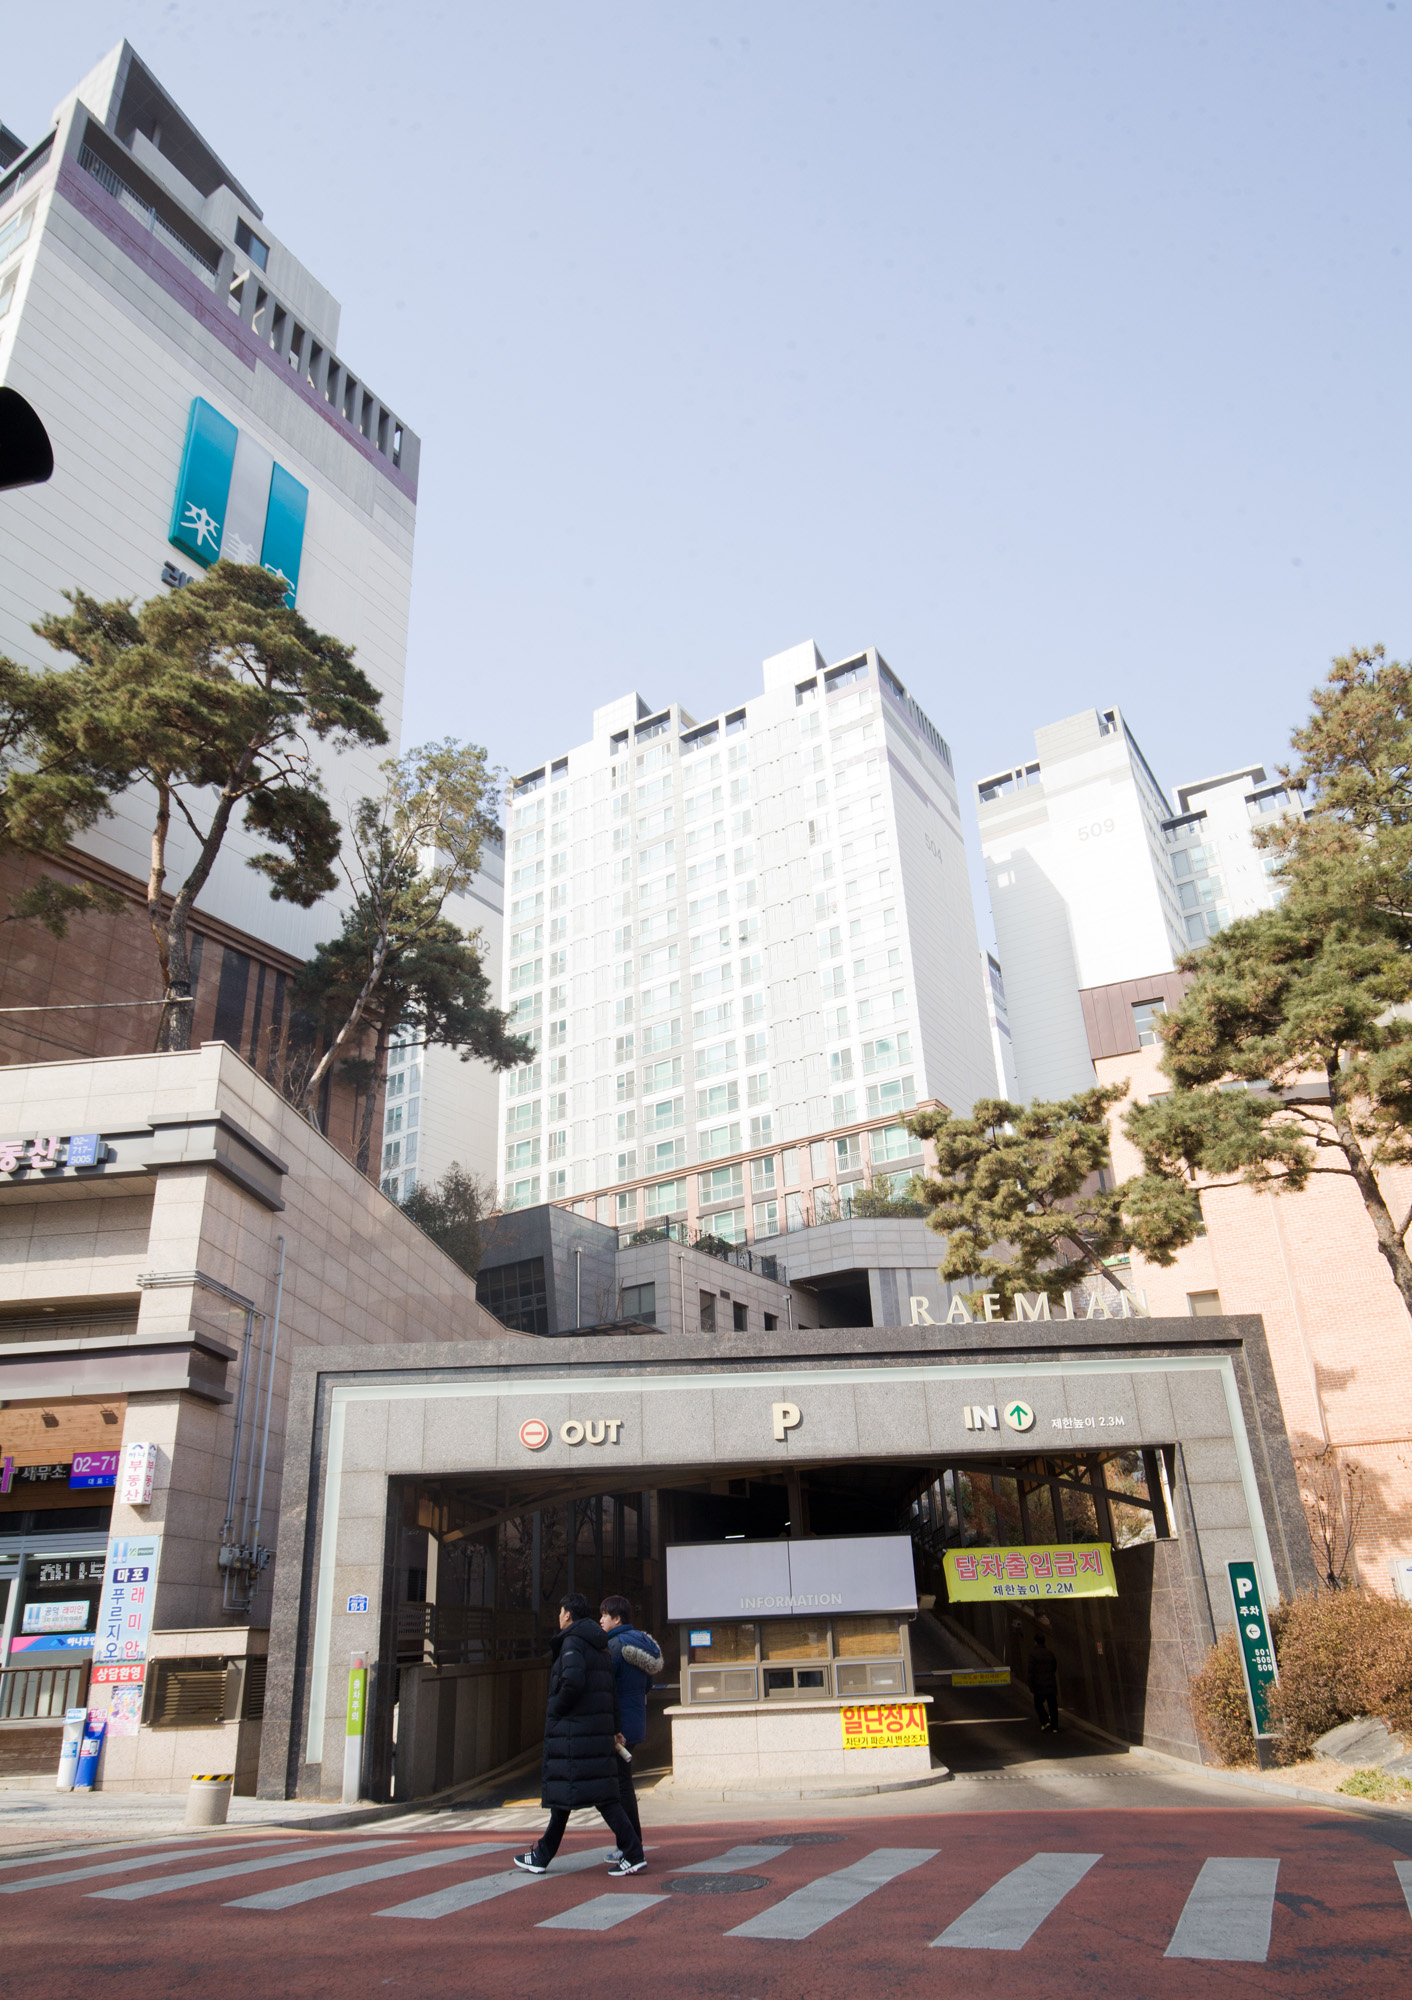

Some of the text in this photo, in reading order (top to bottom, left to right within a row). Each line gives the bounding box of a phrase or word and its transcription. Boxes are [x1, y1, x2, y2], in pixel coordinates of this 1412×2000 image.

[1078, 818, 1115, 841] 509
[924, 832, 943, 864] 504
[72, 1146, 93, 1154] 717-
[73, 1137, 88, 1145] 02-
[70, 1155, 91, 1164] 5005
[909, 1289, 1151, 1325] RAEMIAN
[772, 1402, 802, 1441] P
[963, 1404, 998, 1430] IN
[1051, 1415, 1125, 1430] 제한높이 2.3M
[560, 1419, 622, 1445] OUT
[73, 1456, 120, 1472] 02-71
[124, 1460, 143, 1502] 부동산
[143, 1460, 155, 1502] 부동산
[954, 1549, 1104, 1581] 탑차출입금지
[117, 1568, 144, 1583] 마포
[993, 1583, 1074, 1596] 제한높이 2.2M
[1237, 1578, 1253, 1599] P
[740, 1593, 842, 1609] INFORMATION
[1240, 1605, 1260, 1617] 주차
[103, 1588, 125, 1659] 푸르지오
[125, 1586, 146, 1658] 래미안
[1254, 1648, 1270, 1656] 501
[97, 1666, 141, 1682] 상담환영
[1257, 1664, 1273, 1672] 509
[843, 1705, 925, 1735] 일단정지
[846, 1734, 926, 1746] 차단기 파손시 변상조치
